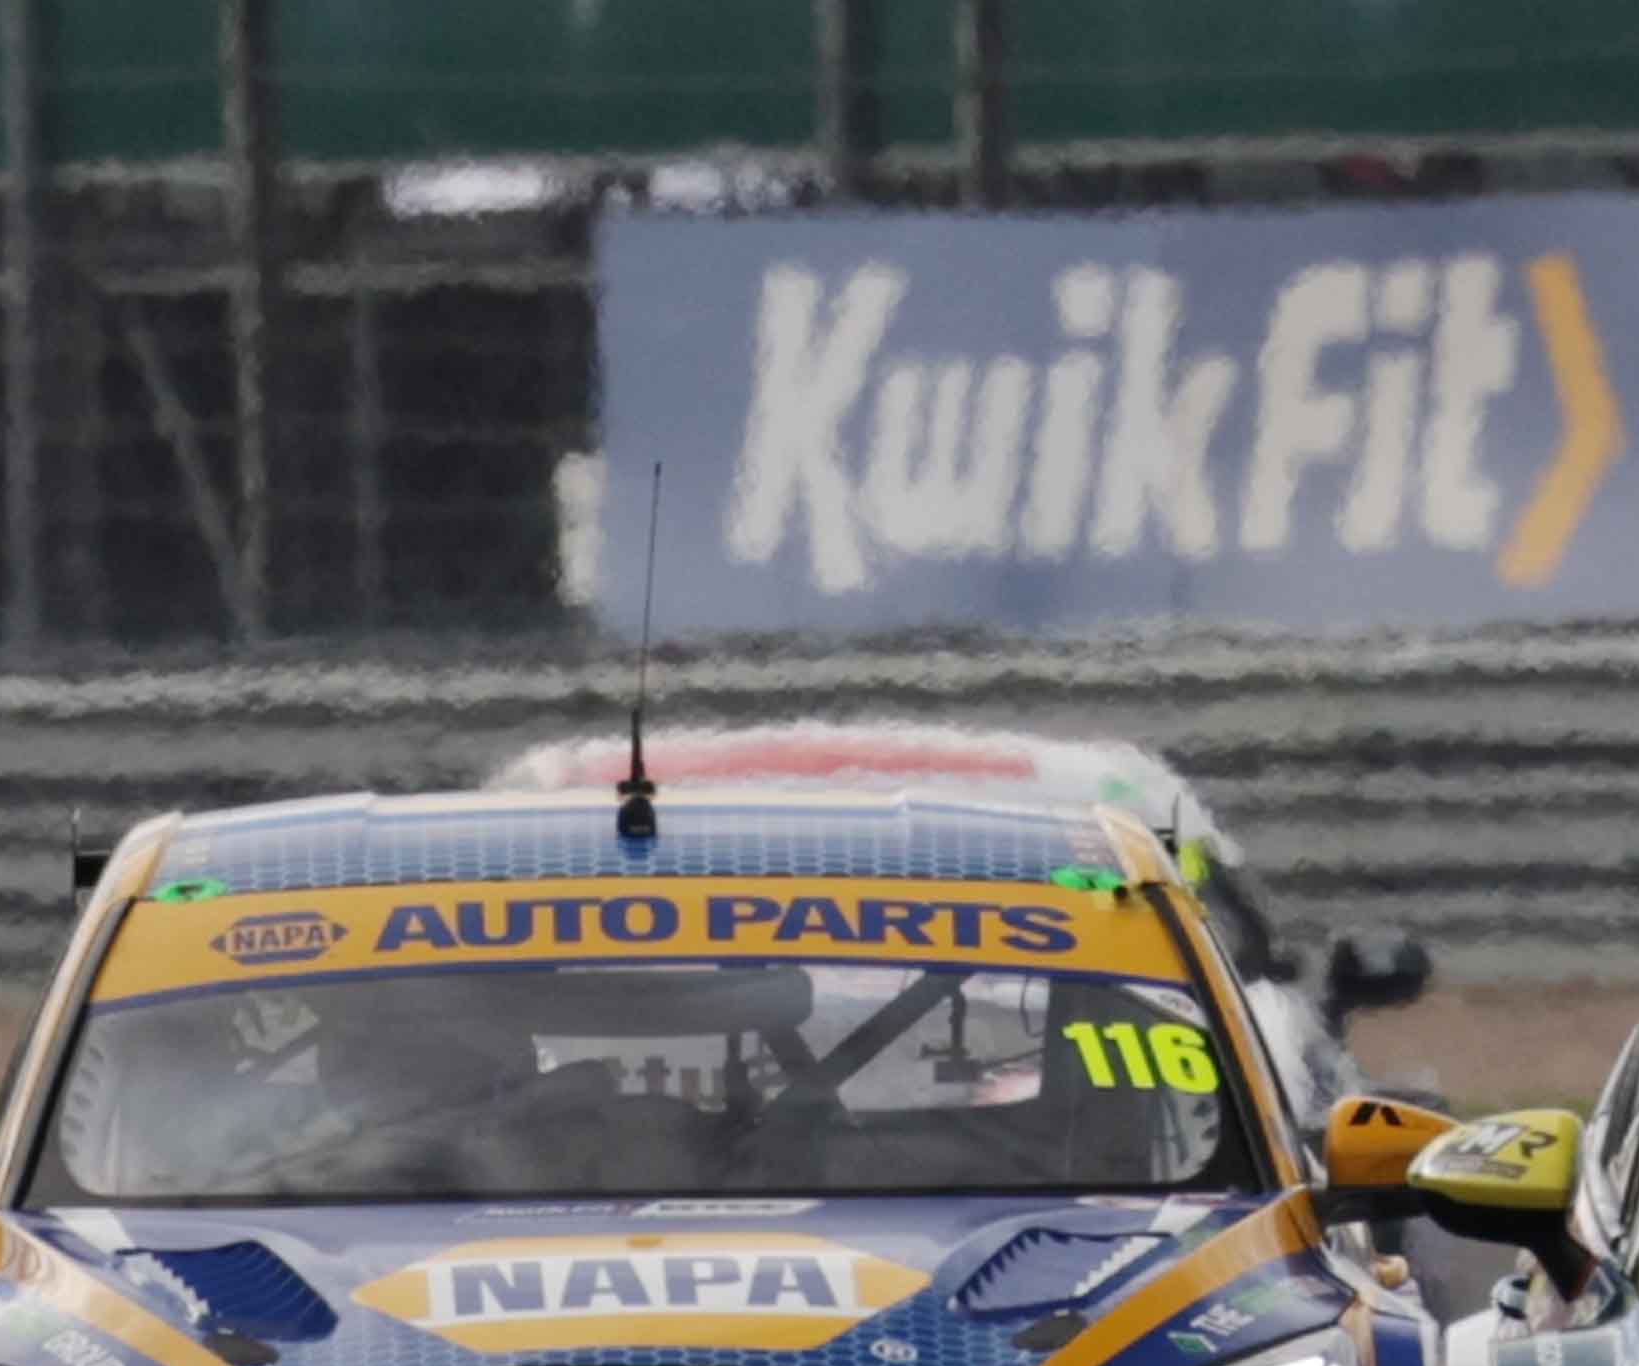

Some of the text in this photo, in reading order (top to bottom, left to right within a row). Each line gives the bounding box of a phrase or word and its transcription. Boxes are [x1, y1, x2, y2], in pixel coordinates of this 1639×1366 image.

[726, 250, 1518, 592] KwikFit
[233, 924, 324, 953] NAPA
[373, 895, 1078, 953] AUTO PARTS
[1063, 1022, 1219, 1094] 116
[451, 1256, 839, 1316] NAPA
